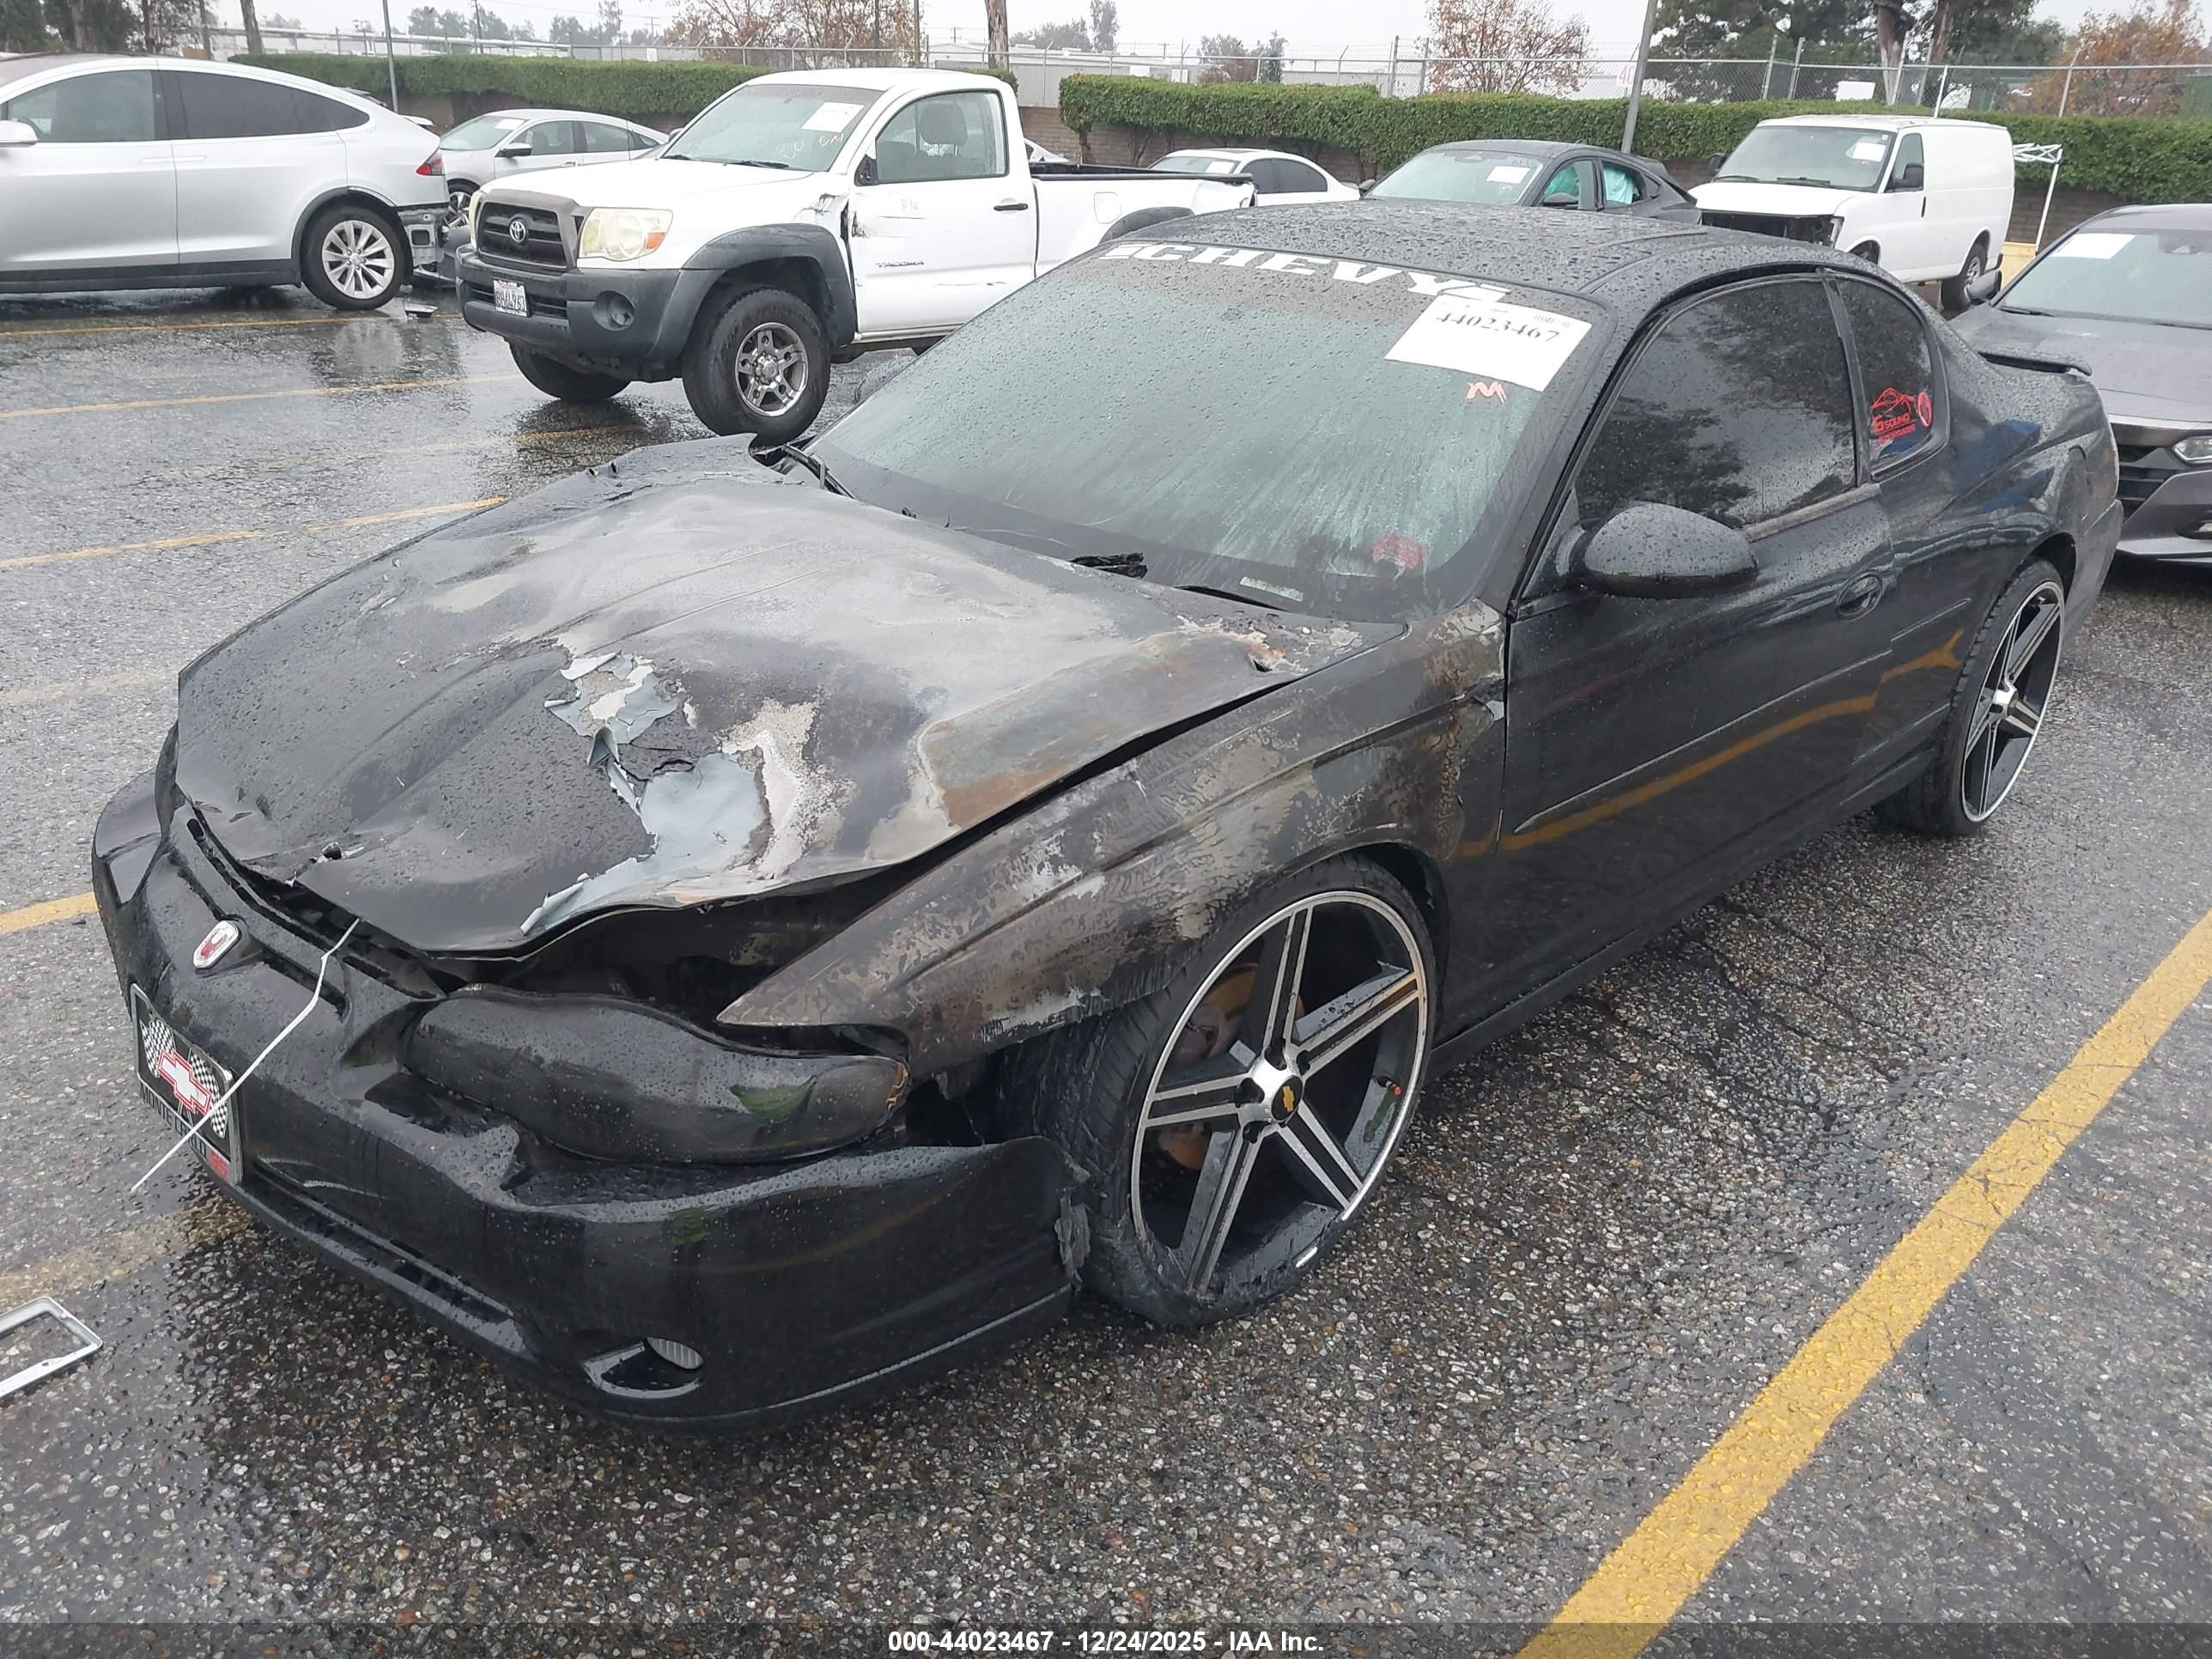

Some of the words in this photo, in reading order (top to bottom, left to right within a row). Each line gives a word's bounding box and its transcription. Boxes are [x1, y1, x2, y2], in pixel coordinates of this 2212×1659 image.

[1132, 243, 1476, 296] CHEVY
[1436, 312, 1560, 342] 44023467
[139, 1081, 173, 1127] MONTE
